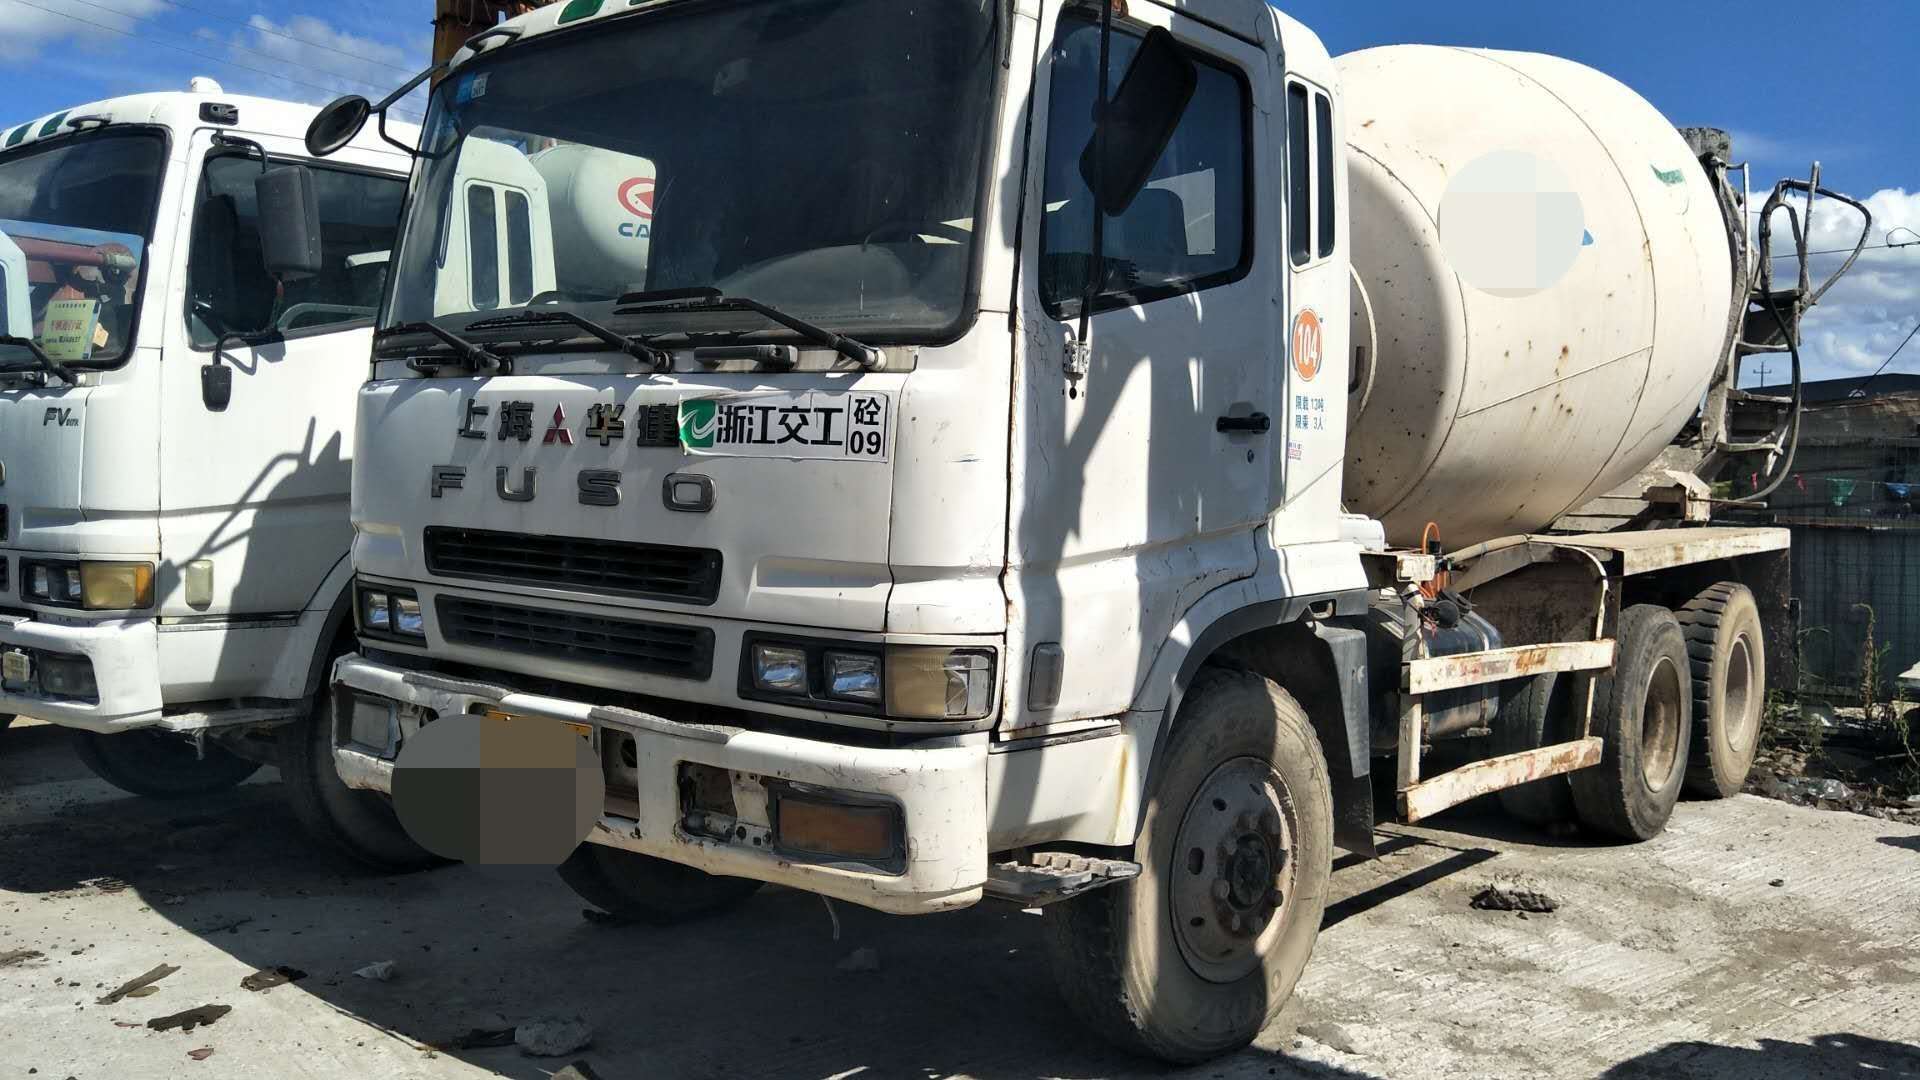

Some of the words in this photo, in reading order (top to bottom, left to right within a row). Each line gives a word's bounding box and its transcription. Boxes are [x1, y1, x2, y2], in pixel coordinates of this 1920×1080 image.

[1298, 323, 1318, 367] 104
[458, 399, 535, 441] 上海
[716, 404, 844, 446] 浙江交工
[854, 398, 882, 426] 砼
[850, 430, 882, 455] 09
[431, 465, 718, 512] FUSO
